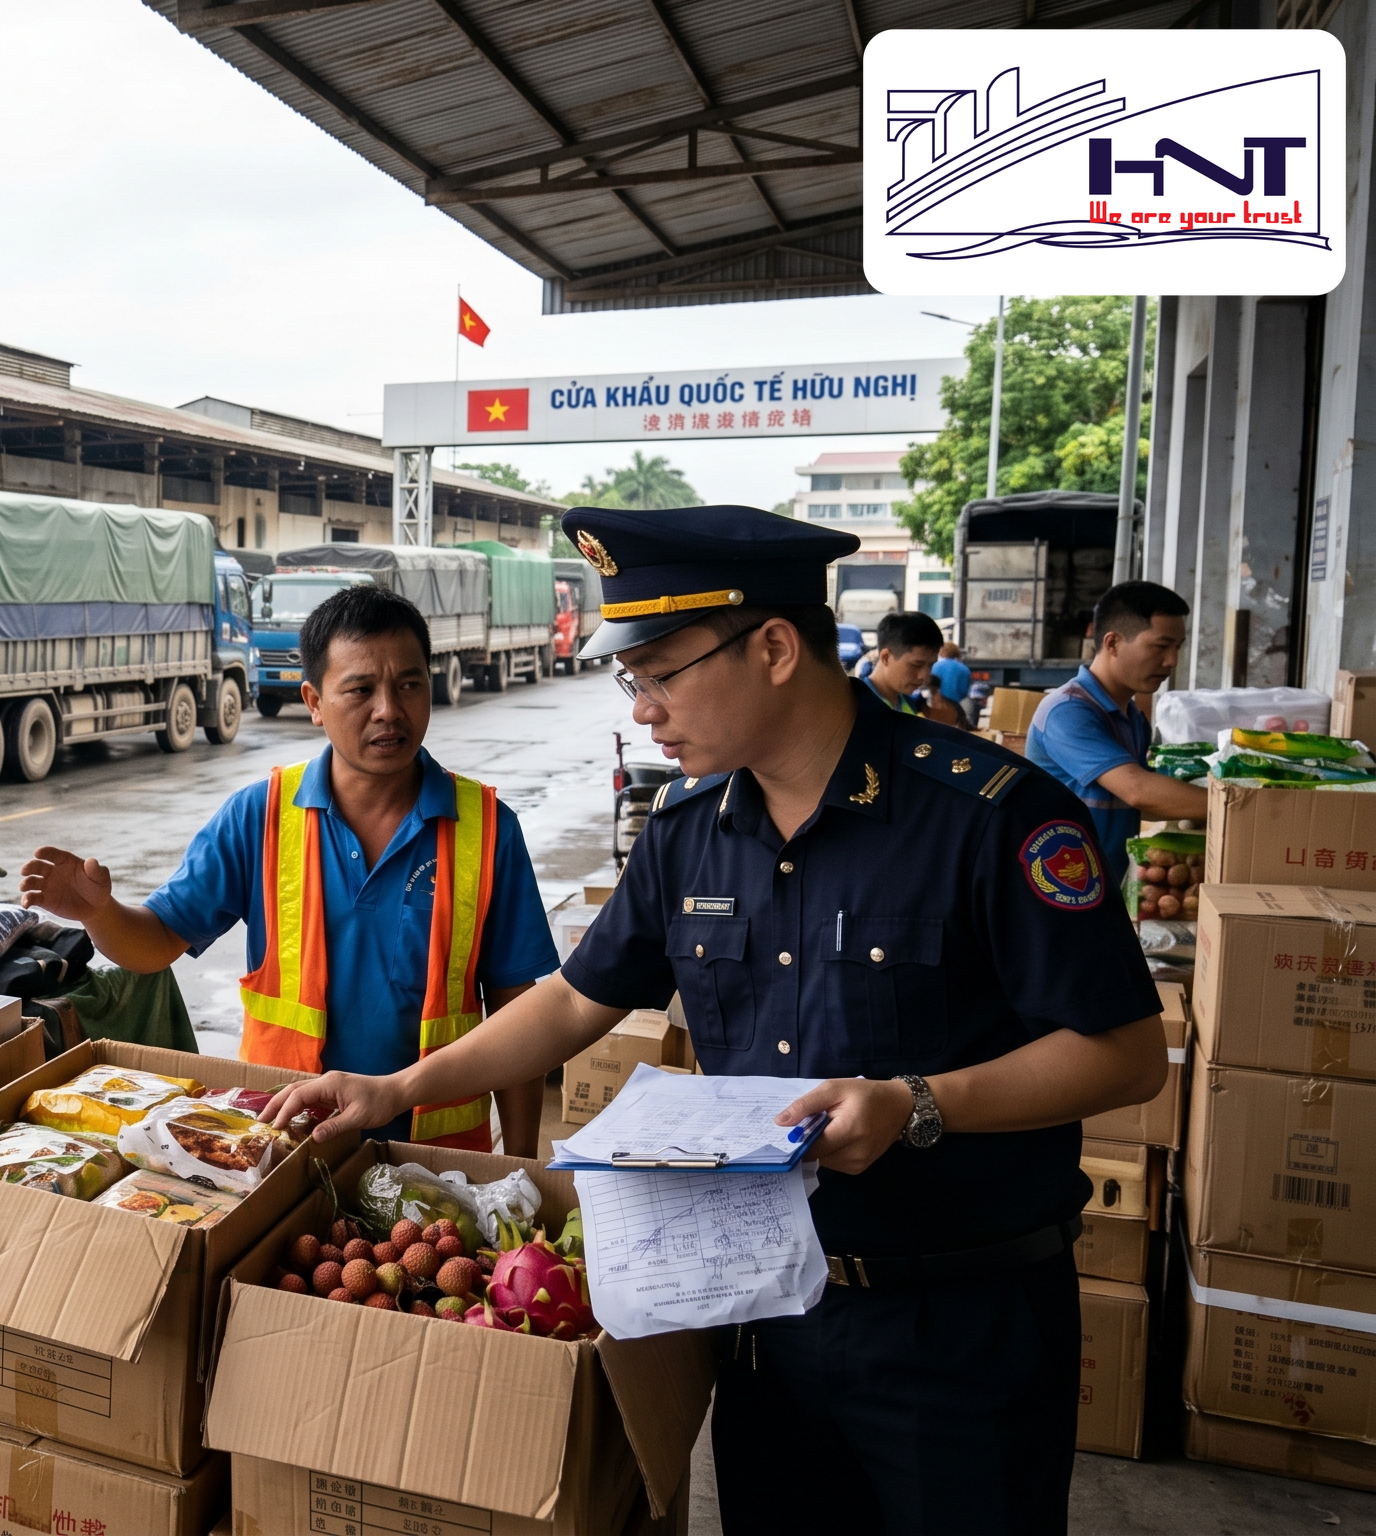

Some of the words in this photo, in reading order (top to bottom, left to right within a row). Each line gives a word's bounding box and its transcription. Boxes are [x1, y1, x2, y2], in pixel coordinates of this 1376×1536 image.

[550, 376, 597, 409] CỬA
[605, 375, 670, 407] KHẨU
[679, 374, 745, 407] QUỐC
[754, 371, 785, 402] TẾ
[792, 373, 845, 400] HỮU
[854, 373, 917, 401] NGHỊ
